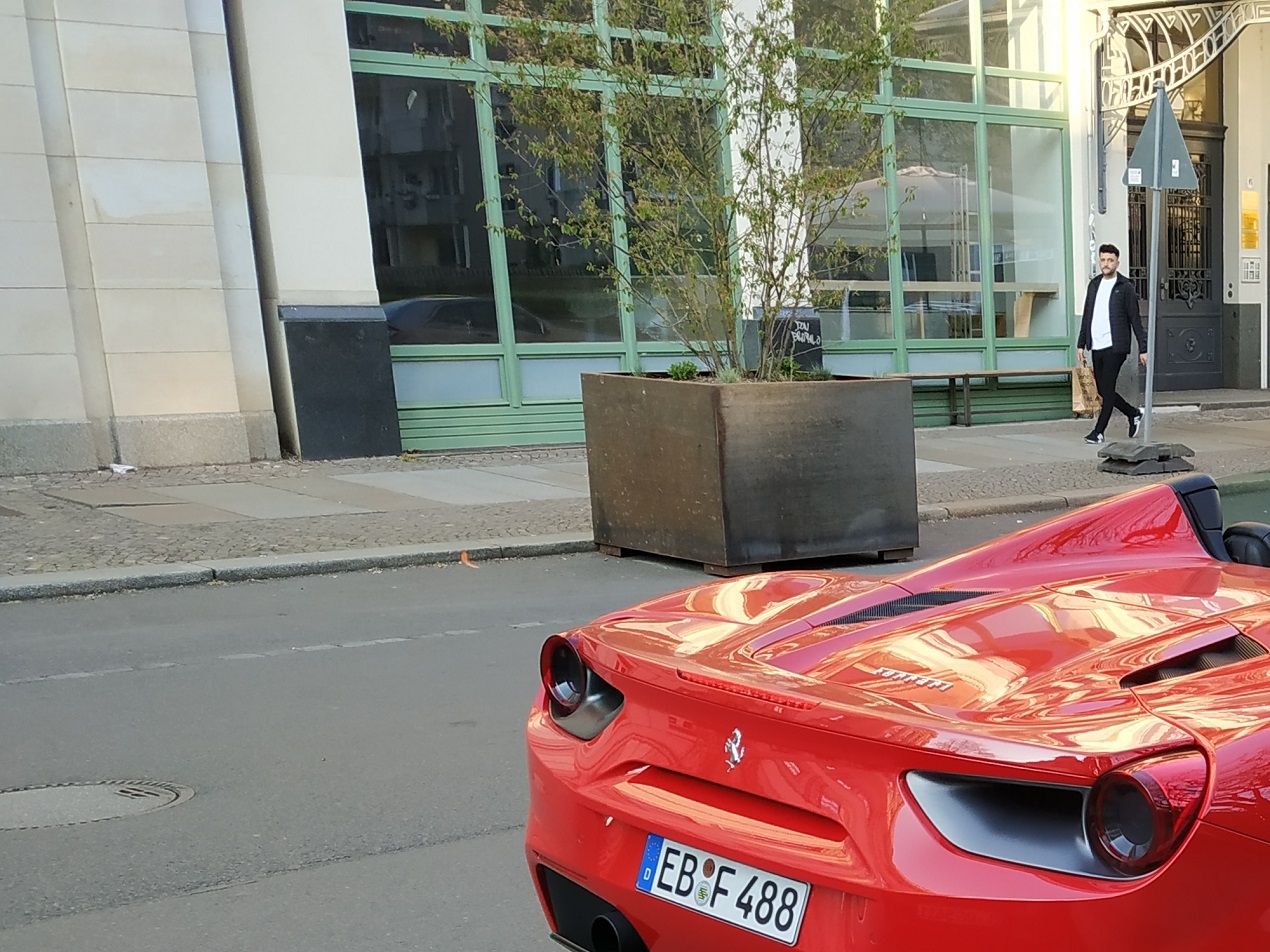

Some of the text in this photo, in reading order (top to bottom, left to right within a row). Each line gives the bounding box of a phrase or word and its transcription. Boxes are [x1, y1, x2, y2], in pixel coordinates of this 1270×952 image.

[643, 868, 651, 881] D
[657, 846, 799, 932] EB F 488
